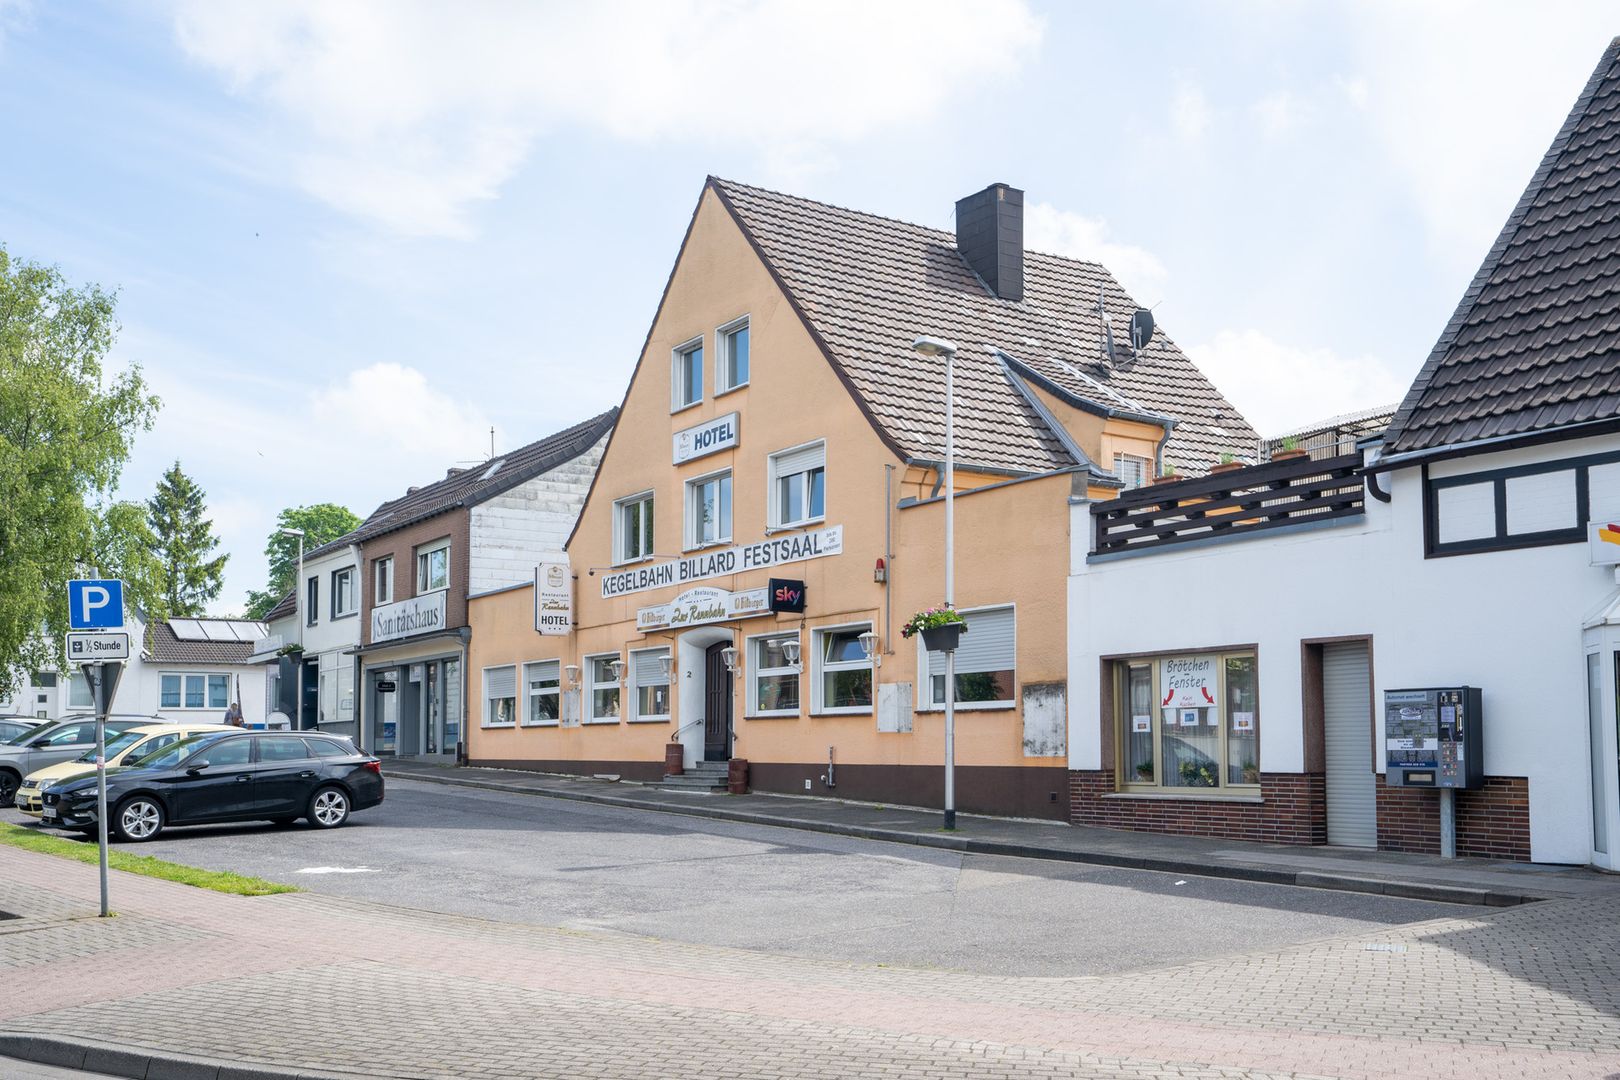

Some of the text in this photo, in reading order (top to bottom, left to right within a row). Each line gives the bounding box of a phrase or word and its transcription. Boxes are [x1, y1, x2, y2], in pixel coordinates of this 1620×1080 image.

[694, 422, 734, 451] HOTEL
[602, 533, 823, 595] KEGELBAHN BILLARD FESTSAAL
[82, 586, 110, 623] P
[776, 586, 801, 605] sky
[376, 603, 439, 638] Sanitätshaus
[541, 615, 570, 626] HOTEL
[689, 602, 726, 624] Rennbahn
[94, 640, 121, 650] Stunde
[686, 670, 692, 678] 2
[1167, 657, 1210, 674] Brötchen
[1168, 675, 1207, 689] Fenster
